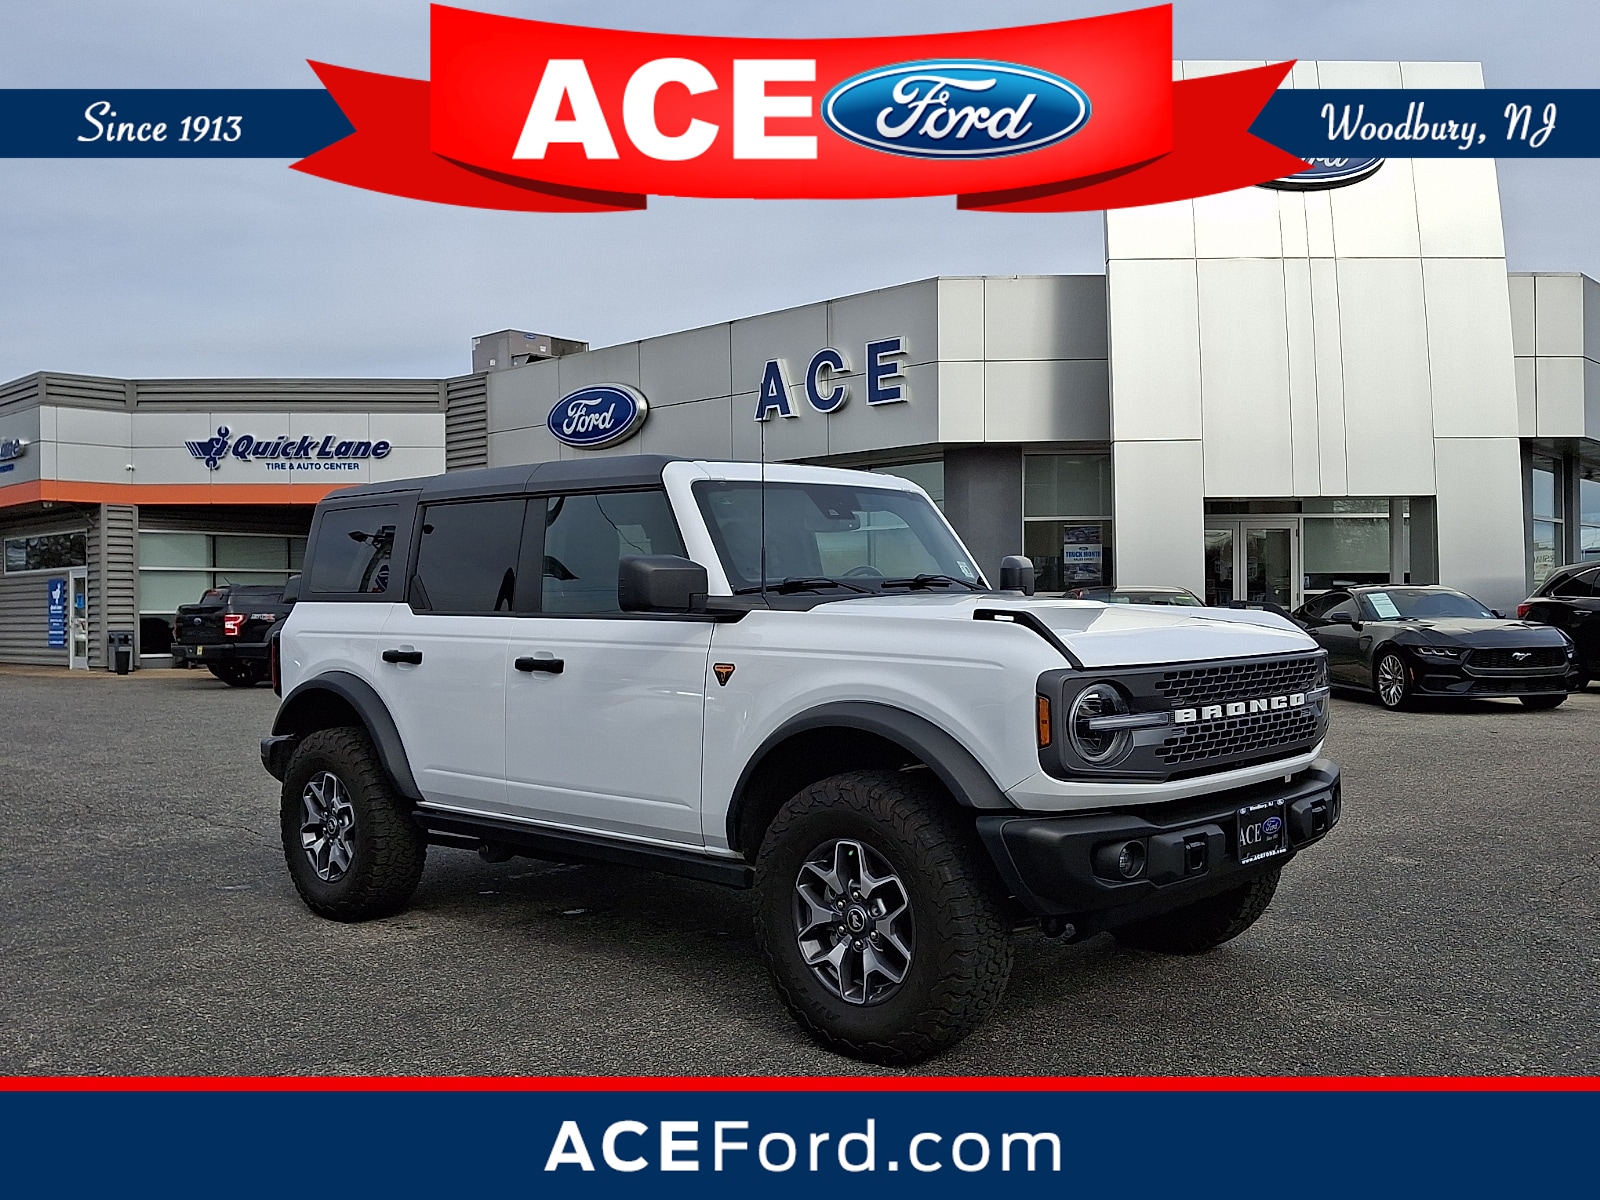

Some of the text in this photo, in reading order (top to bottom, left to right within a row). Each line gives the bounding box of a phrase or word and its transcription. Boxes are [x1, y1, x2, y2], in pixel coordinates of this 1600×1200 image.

[754, 336, 907, 421] ACE
[563, 398, 615, 434] Ford
[266, 462, 360, 470] TIRE & AUTO CENTER
[1174, 693, 1305, 723] BRONCO
[1240, 823, 1262, 847] ACE
